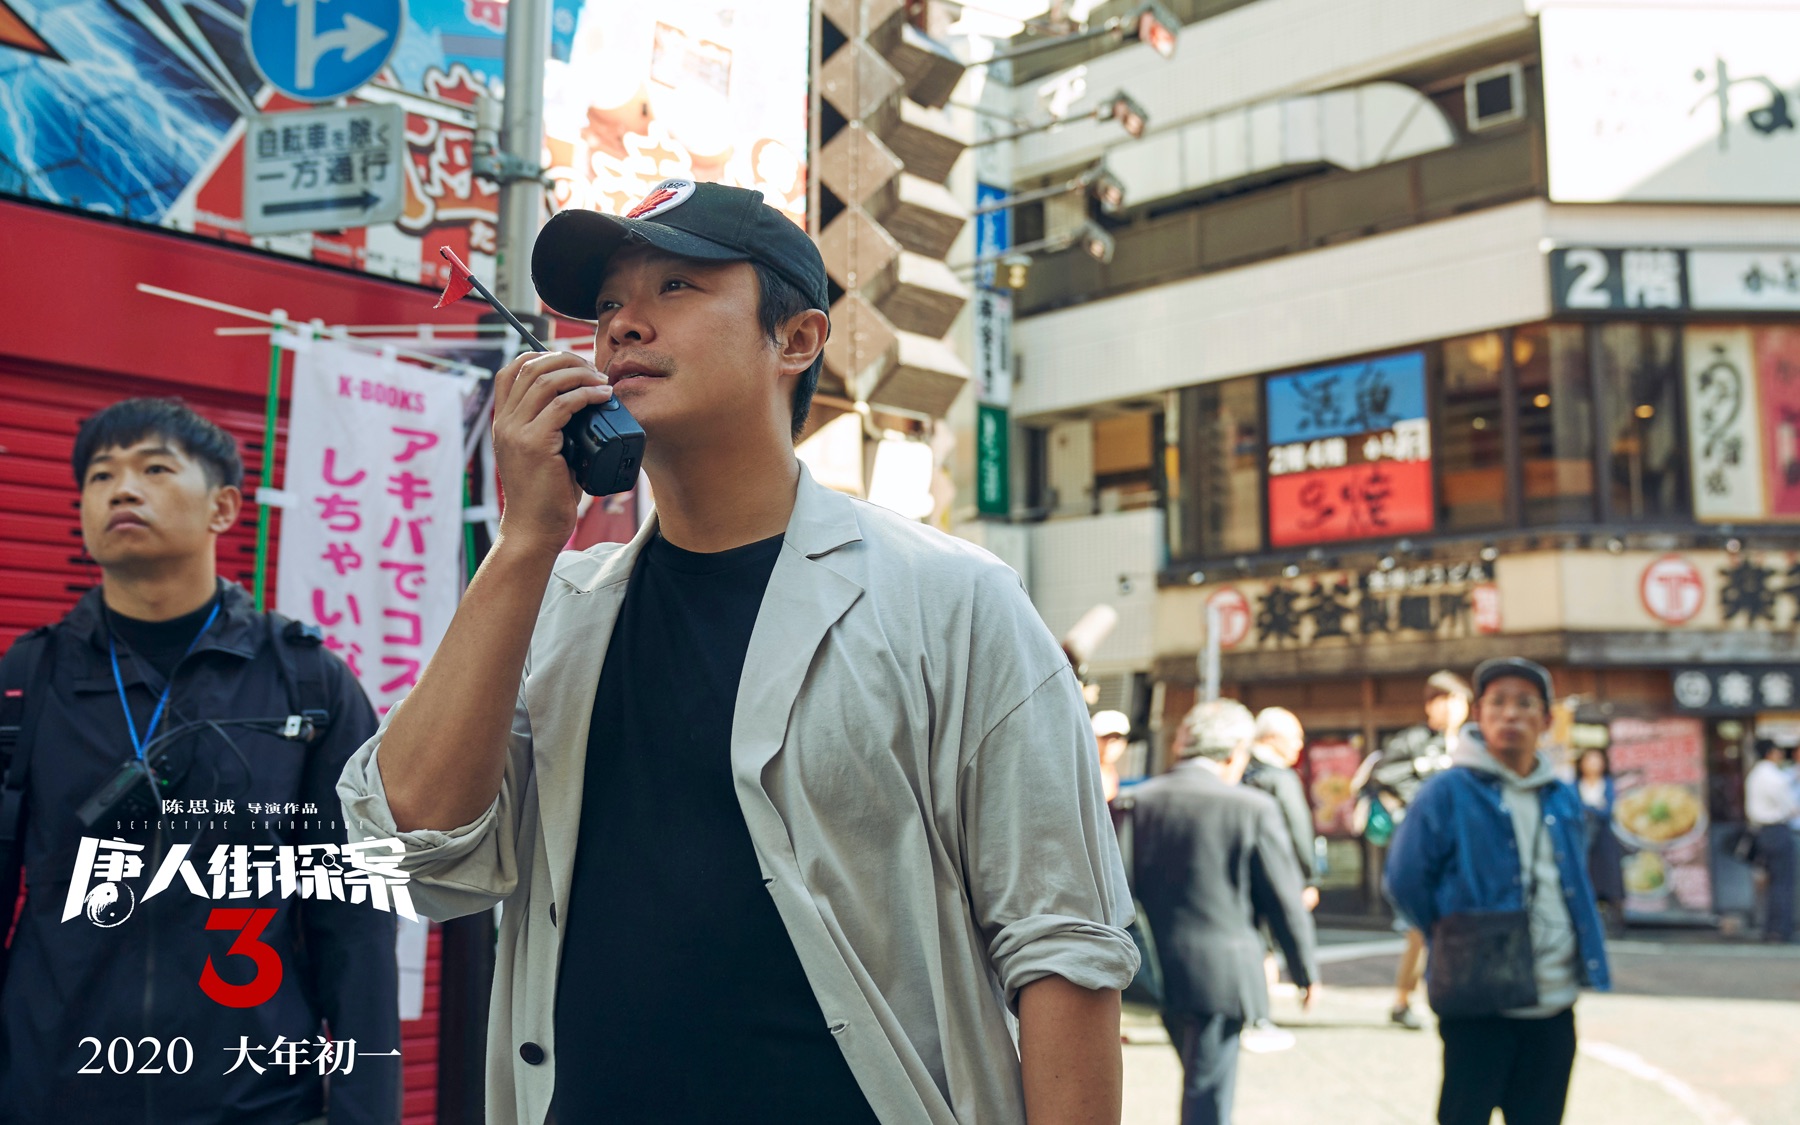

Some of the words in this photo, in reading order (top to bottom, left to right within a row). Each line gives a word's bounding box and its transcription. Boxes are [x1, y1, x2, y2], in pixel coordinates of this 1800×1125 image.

[258, 117, 390, 159] 自転車を除く
[256, 151, 390, 189] 一方通行
[1564, 249, 1682, 309] 2階
[339, 375, 425, 414] K-BOOKS
